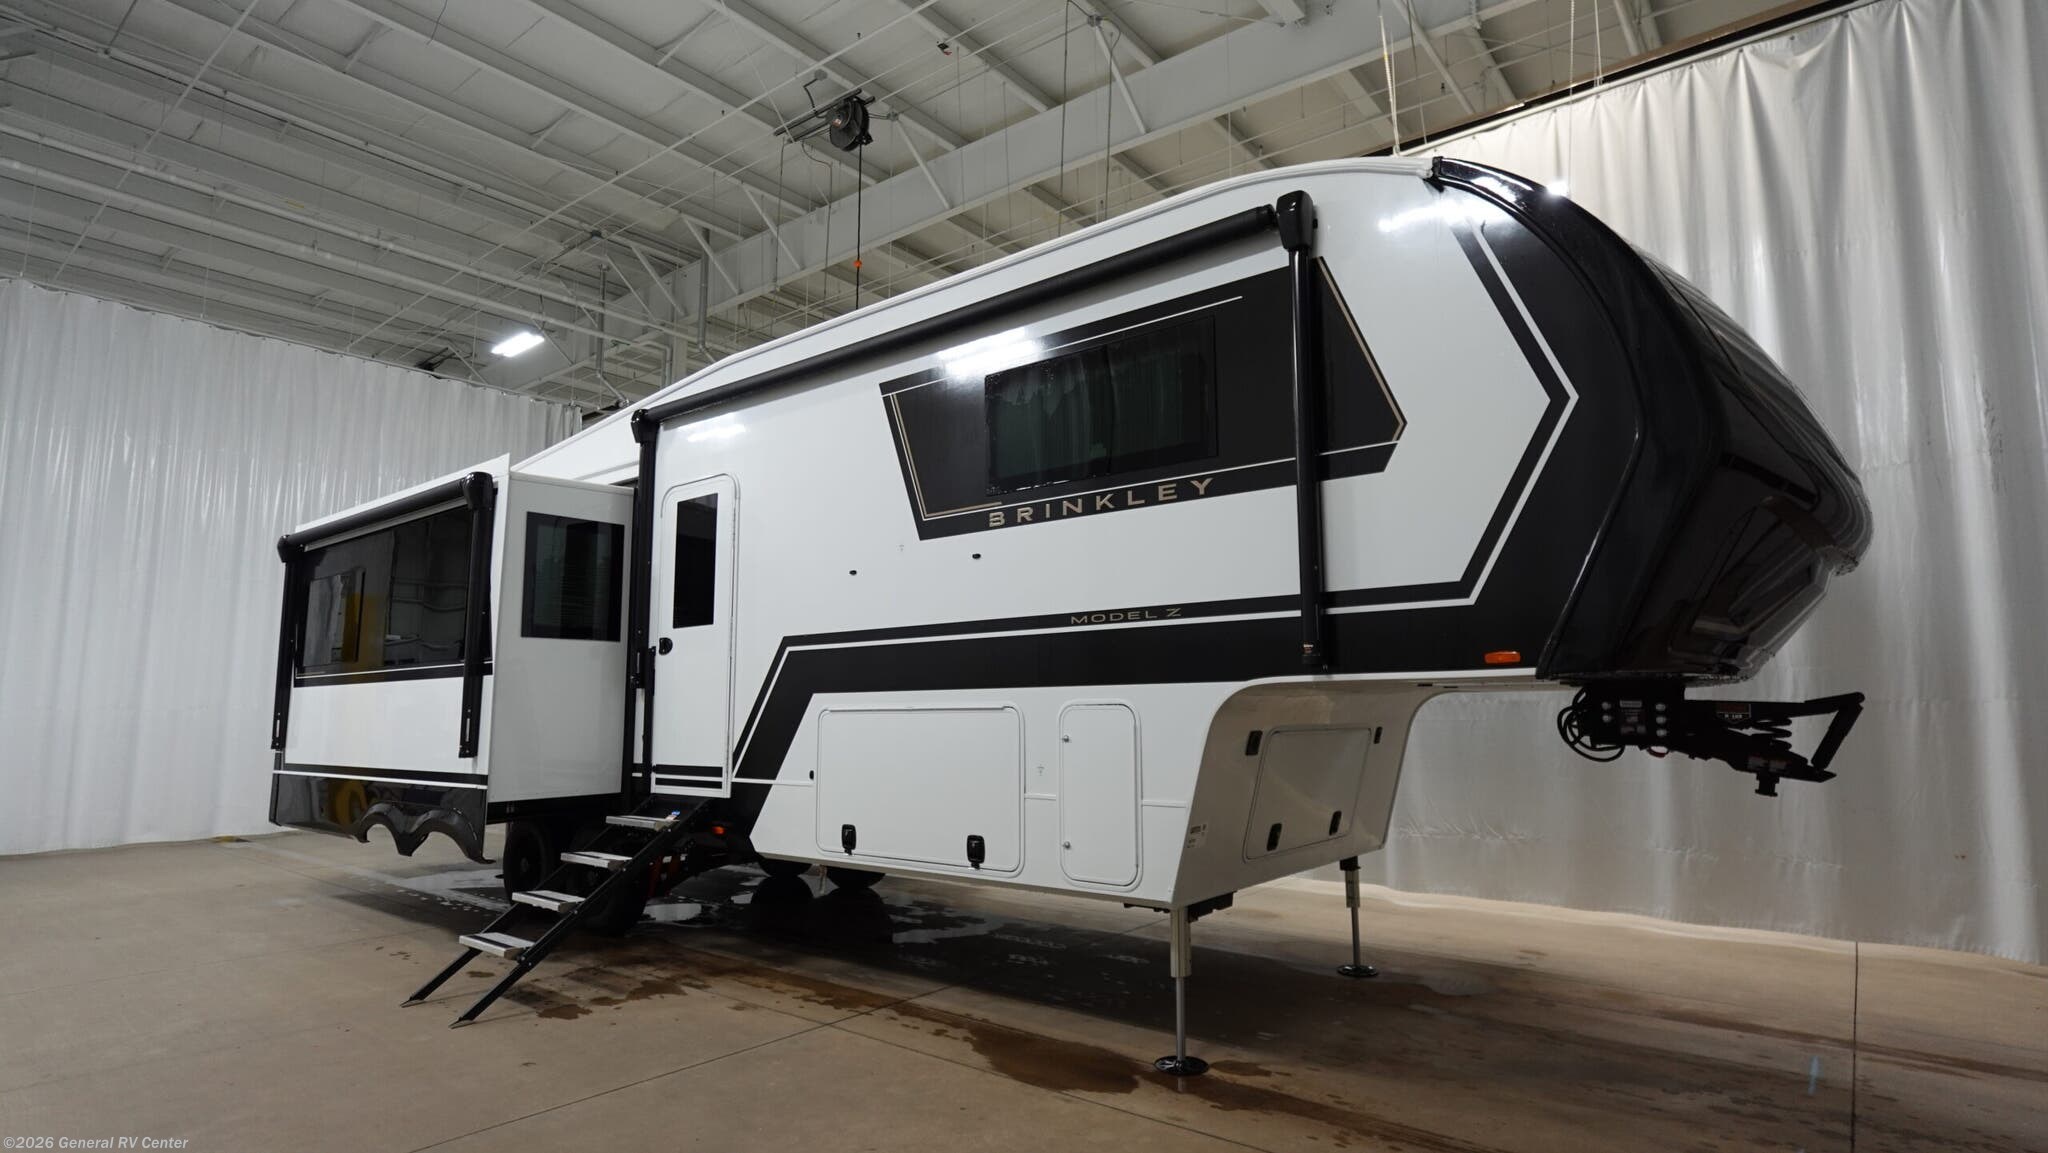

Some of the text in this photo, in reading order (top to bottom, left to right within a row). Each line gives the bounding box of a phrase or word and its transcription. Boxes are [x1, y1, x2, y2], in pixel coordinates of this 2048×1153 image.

[989, 478, 1214, 527] BRINKLEY
[1071, 608, 1182, 624] MODEL Z
